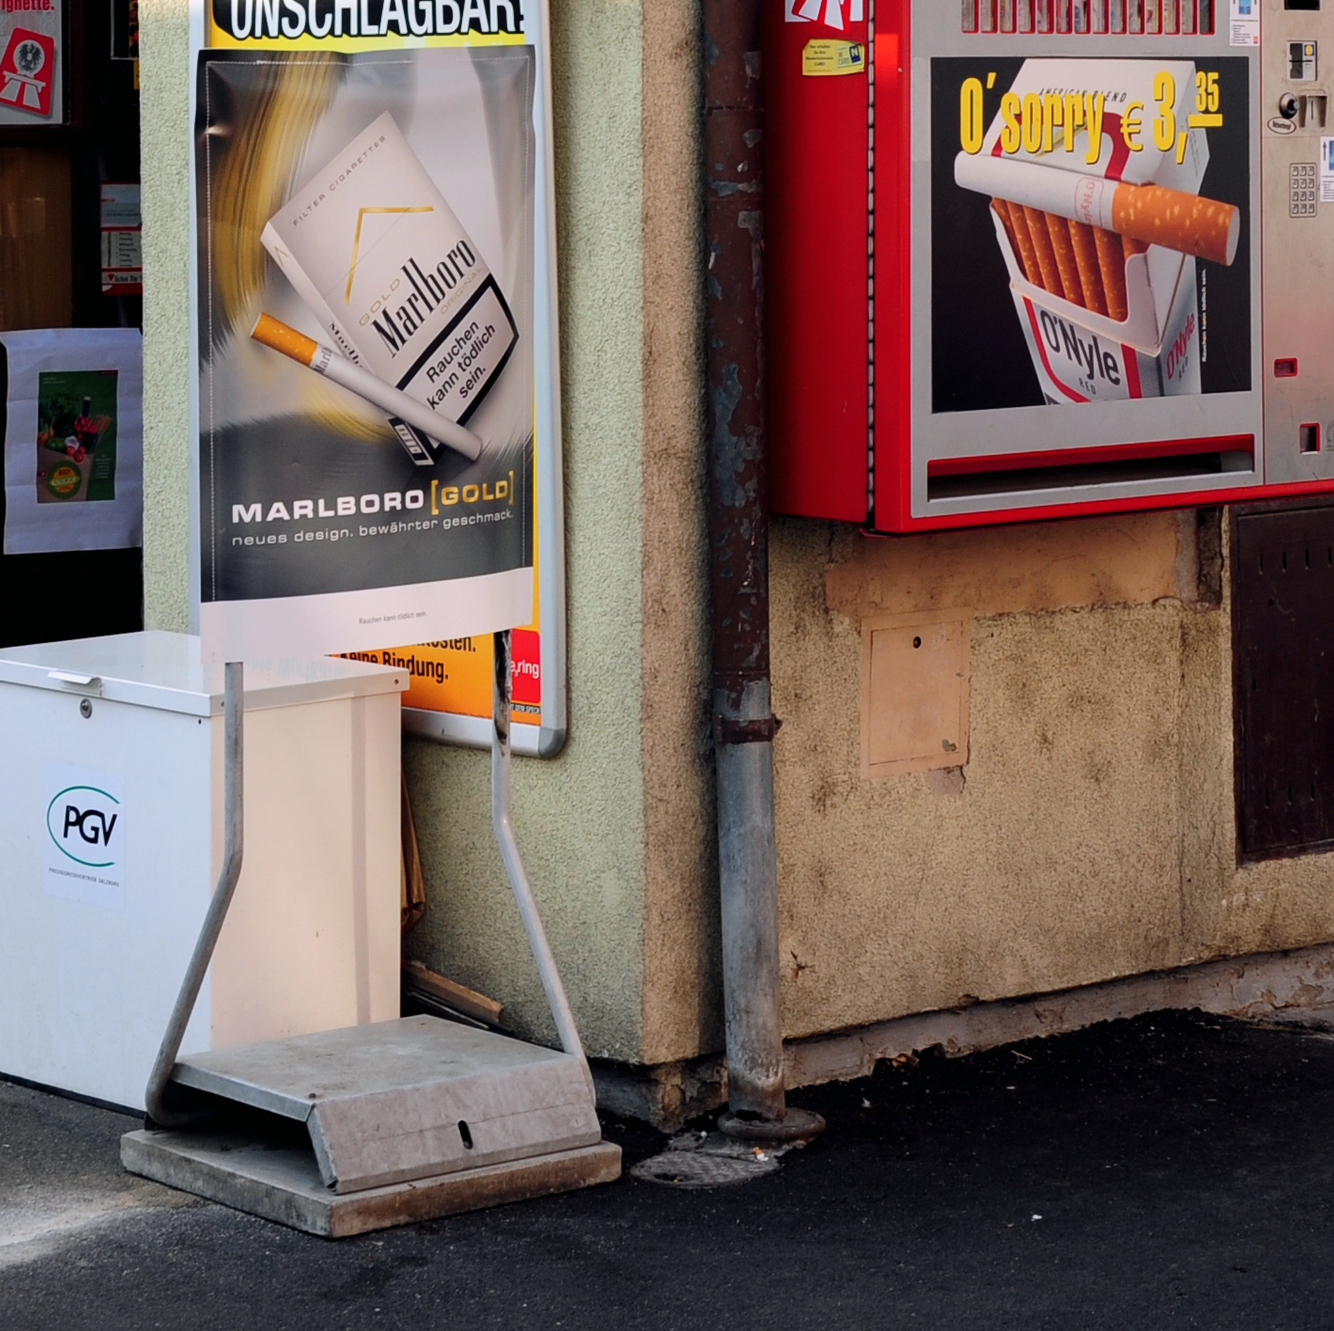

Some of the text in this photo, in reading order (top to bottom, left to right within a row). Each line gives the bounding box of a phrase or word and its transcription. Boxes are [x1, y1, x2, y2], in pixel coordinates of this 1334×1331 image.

[292, 134, 387, 228] FILTER CIGARETTES
[358, 277, 401, 329] GOLD
[369, 238, 477, 359] Marlboro
[439, 266, 483, 316] ORIGINAL
[425, 320, 479, 384] Rauchen
[426, 323, 496, 411] kann tödlich
[1040, 309, 1121, 386] O'Nyle
[458, 364, 487, 400] sein.
[1078, 377, 1097, 396] RED
[232, 489, 425, 525] MARLBORO
[232, 508, 514, 547] neues design. bewährter geschmack.
[63, 805, 118, 847] PGV
